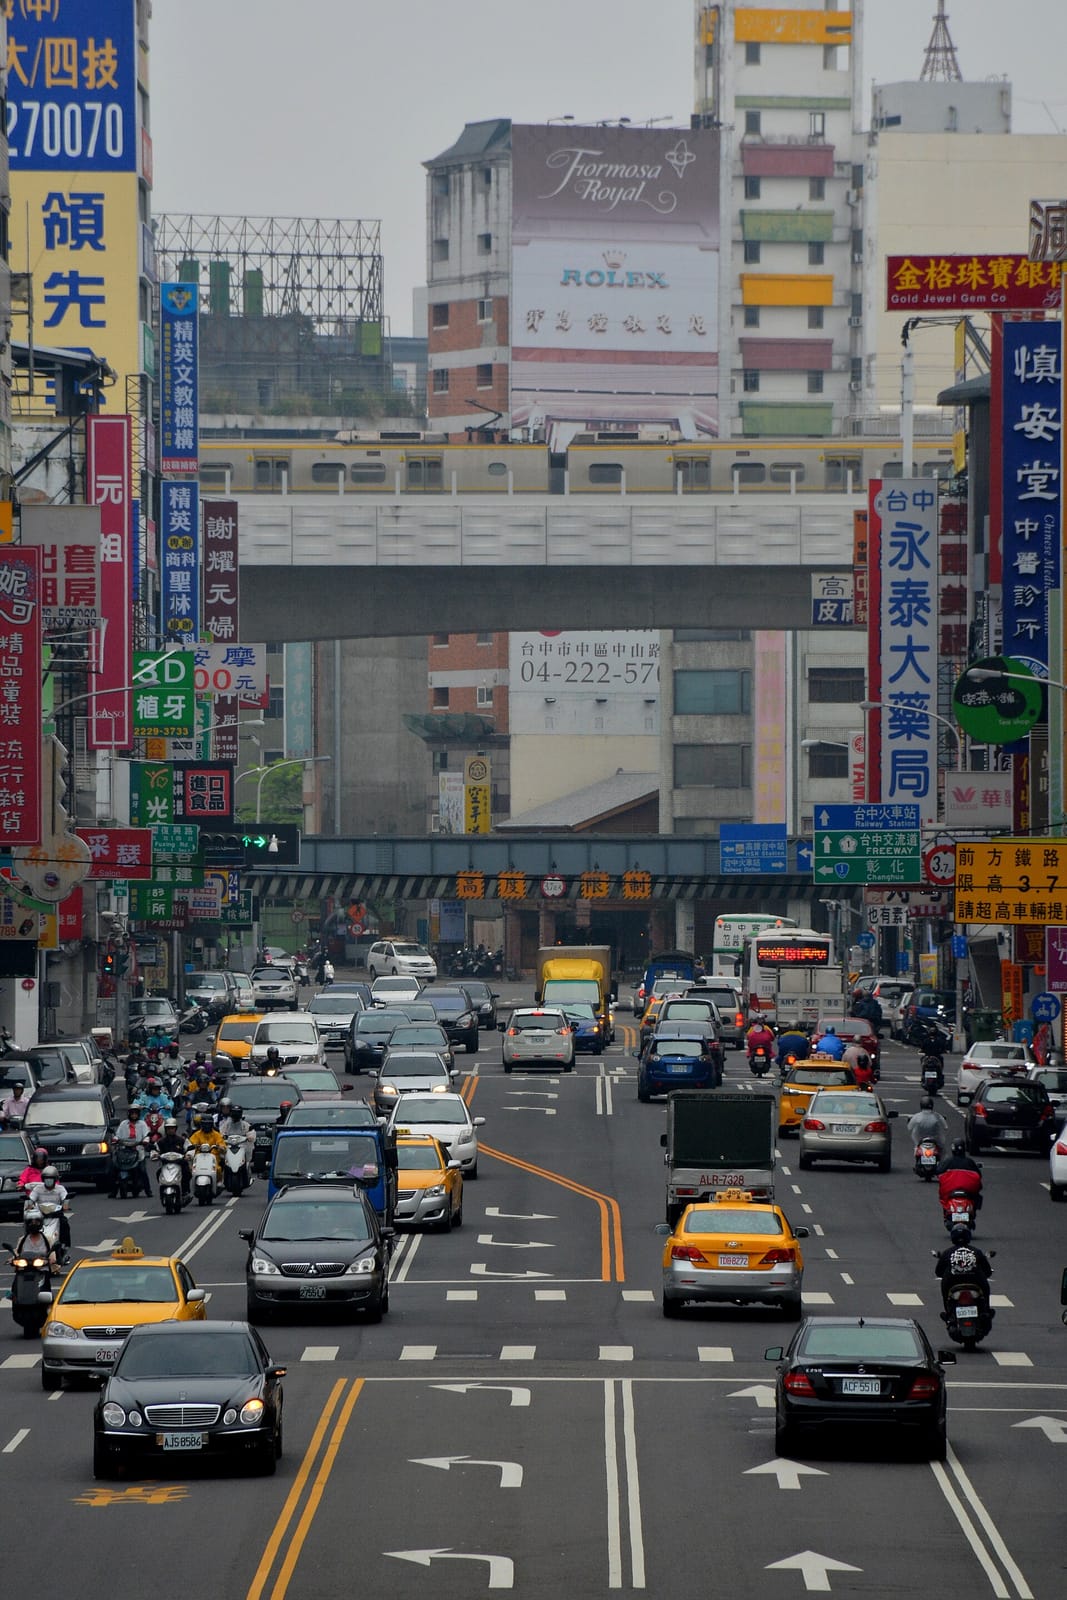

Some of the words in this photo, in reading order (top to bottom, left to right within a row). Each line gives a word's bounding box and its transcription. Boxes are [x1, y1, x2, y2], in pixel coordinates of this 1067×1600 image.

[7, 101, 123, 157] 270070
[574, 178, 677, 214] Royal
[42, 192, 106, 328] 領先
[560, 268, 669, 288] ROLEX
[891, 294, 919, 304] Gold
[923, 294, 956, 303] Jewel
[961, 294, 986, 303] Gem
[991, 294, 1007, 302] Co
[174, 320, 194, 450] 精英文教機構
[1014, 345, 1061, 501] 慎安堂
[168, 487, 191, 532] 精英
[886, 489, 934, 512] 台中
[1044, 514, 1055, 561] Chinese
[166, 552, 196, 567] 商科
[1012, 517, 1041, 640] 中醫診所
[169, 571, 191, 615] 聖林
[887, 521, 931, 798] 永泰大藥局
[138, 659, 186, 683] 3D
[137, 695, 186, 719] 植牙
[134, 728, 189, 736] 2229-3733
[190, 776, 224, 792] 進口
[853, 806, 916, 821] 台中火車站
[855, 820, 883, 829] Railway
[889, 820, 916, 828] Station
[860, 833, 918, 847] 台中交流道
[866, 848, 913, 856] FREEWAY
[958, 848, 1060, 867] 前方鐵路
[866, 860, 904, 873] 彰化
[229, 874, 239, 887] 24
[463, 876, 478, 893] 高
[504, 877, 521, 894] 度
[586, 878, 604, 894] 限
[629, 877, 645, 894] 制
[867, 873, 905, 882] Changhua
[958, 901, 1067, 921] 請超高車輛提
[700, 1174, 745, 1185] ALR-7328
